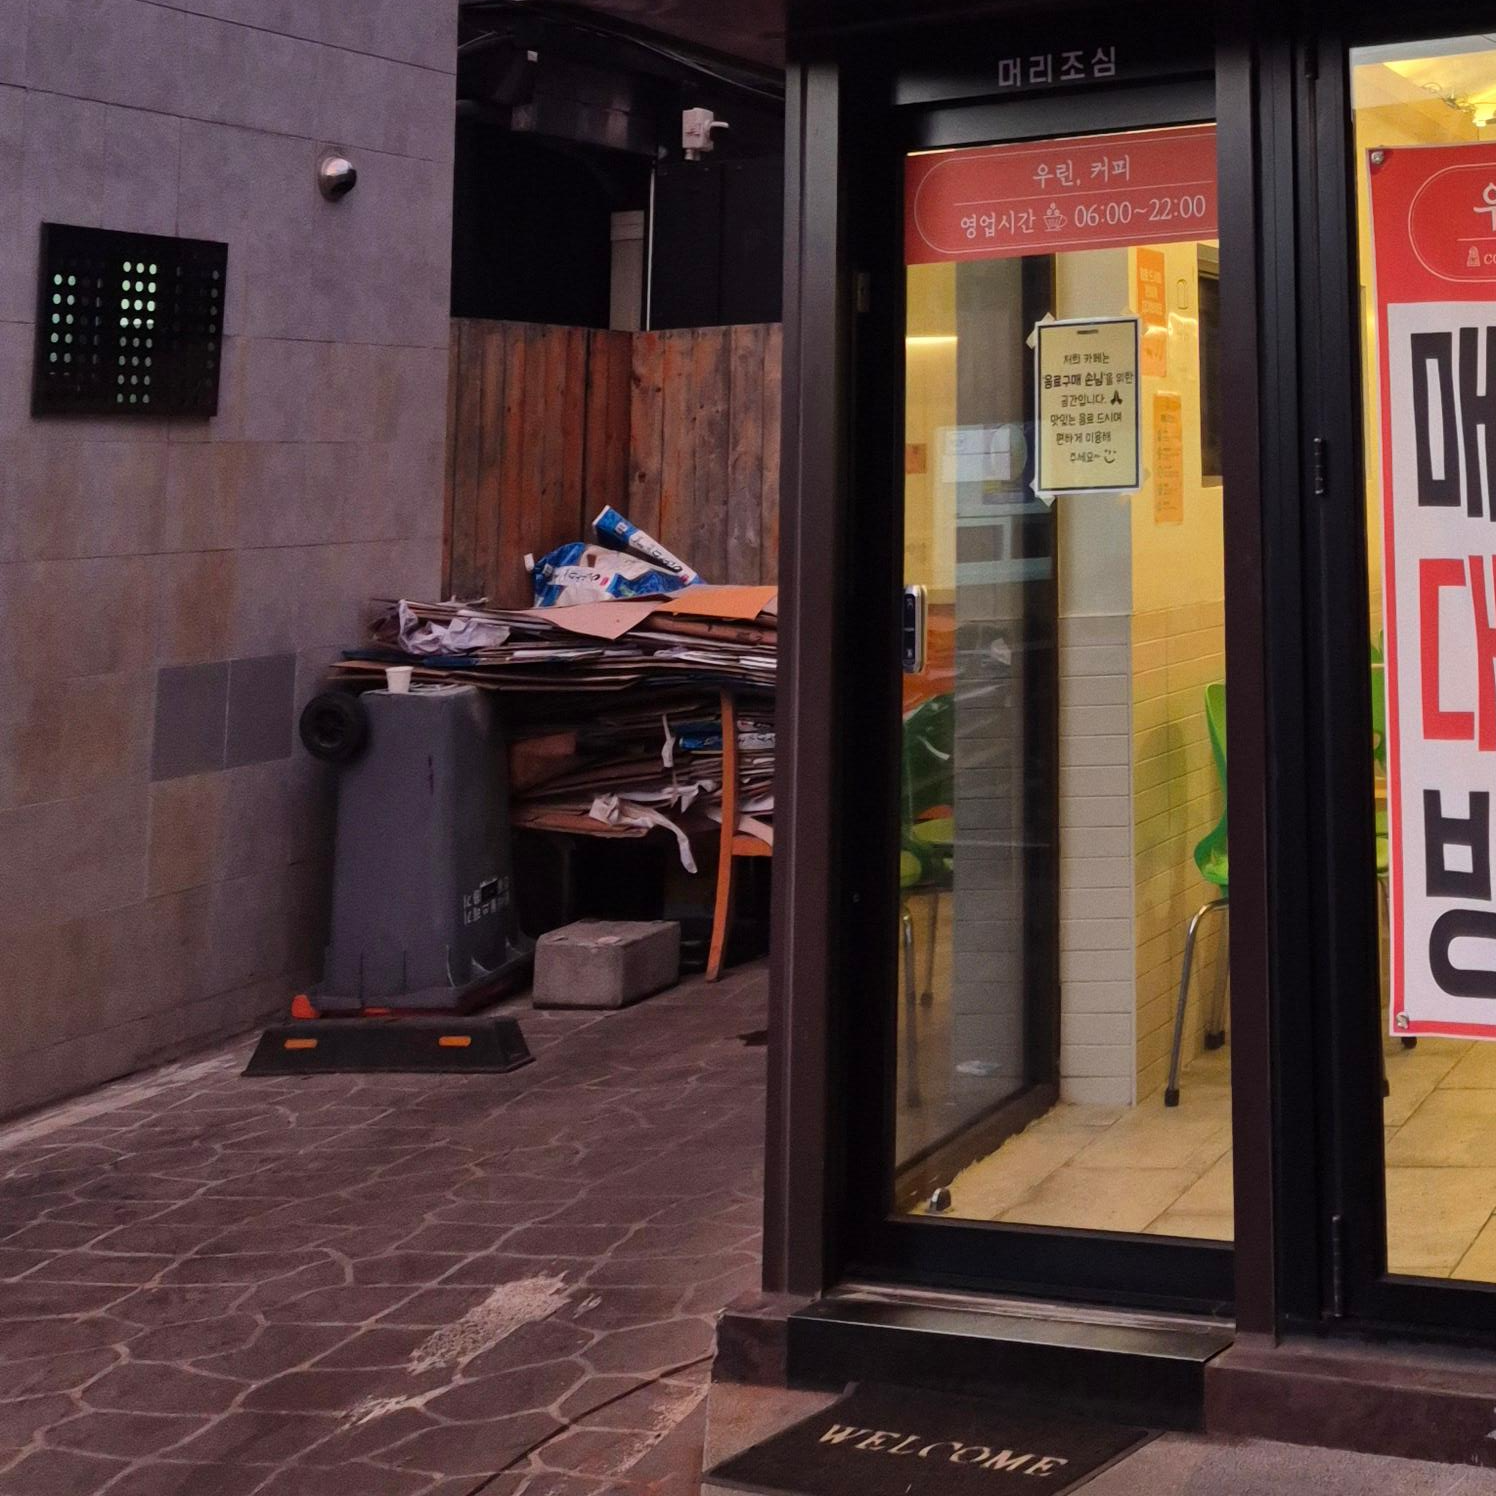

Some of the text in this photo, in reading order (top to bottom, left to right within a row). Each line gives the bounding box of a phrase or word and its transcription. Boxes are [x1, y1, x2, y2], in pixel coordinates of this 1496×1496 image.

[998, 47, 1117, 88] 머리조심
[1033, 155, 1131, 188] 우린, 커피
[960, 195, 1206, 239] 영업시간 06:00~22:00
[1063, 352, 1110, 365] 저희 카페는
[1116, 371, 1134, 384] 위한
[1050, 413, 1075, 426] 맛있는
[1079, 412, 1094, 425] 음료
[1056, 431, 1111, 445] 편하게 이용해
[818, 1423, 1070, 1478] WELCOME
